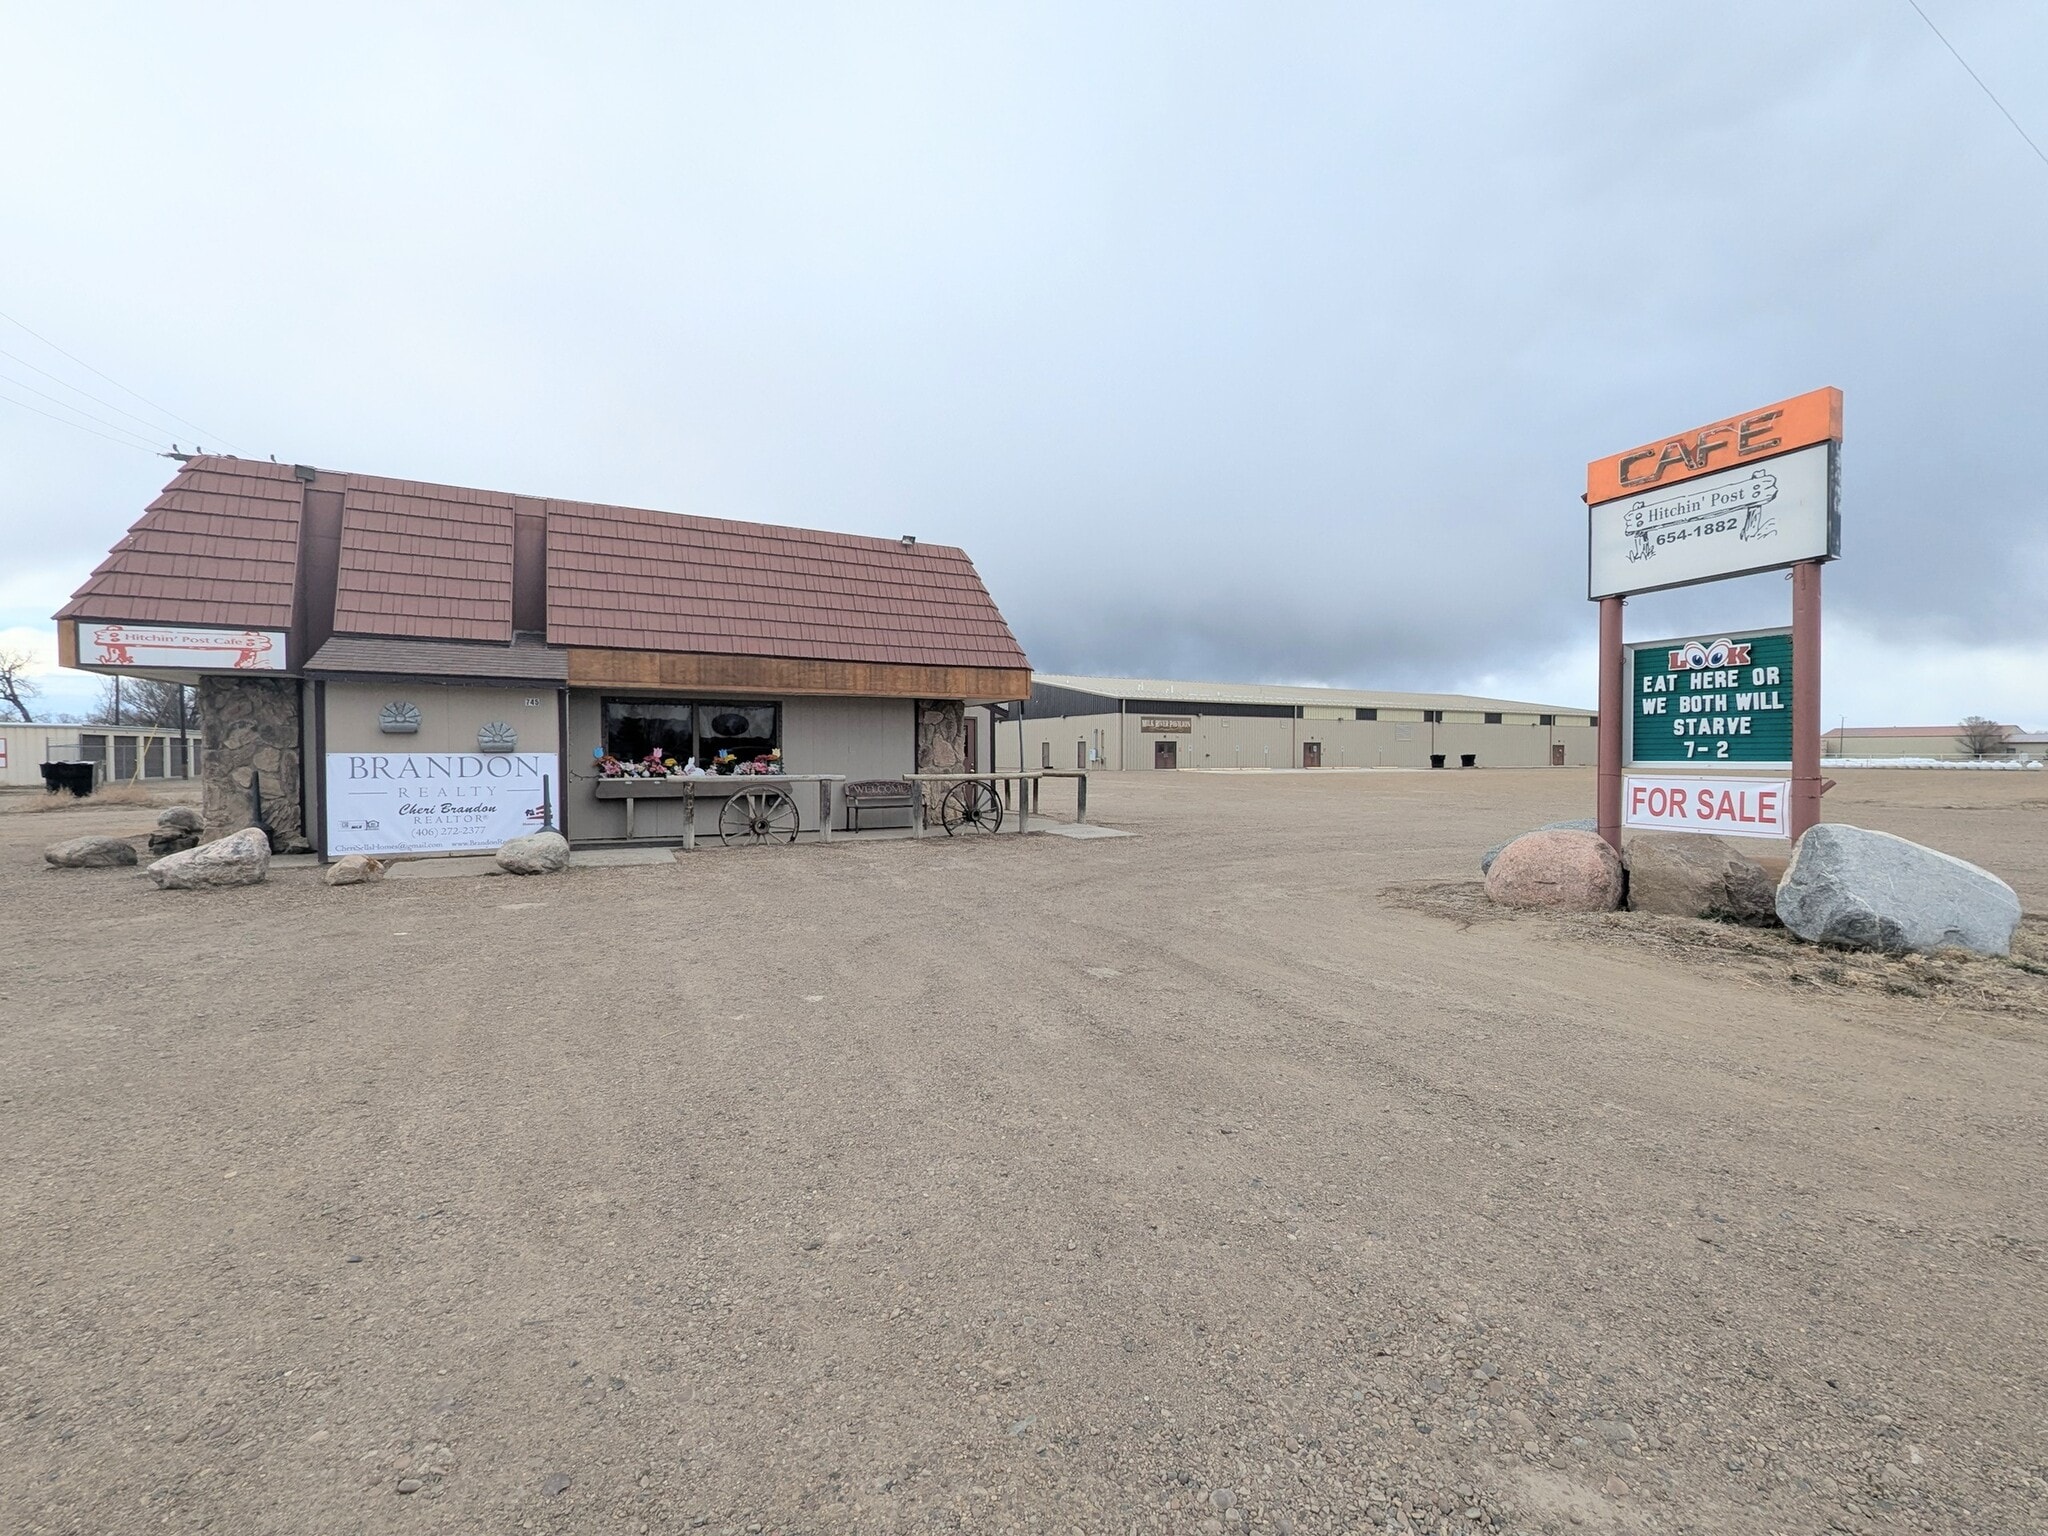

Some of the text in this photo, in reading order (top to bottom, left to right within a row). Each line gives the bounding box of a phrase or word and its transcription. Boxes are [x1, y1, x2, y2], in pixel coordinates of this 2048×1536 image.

[1618, 409, 1784, 487] CAFE
[1648, 488, 1746, 522] Hitchin' Post
[1656, 518, 1738, 545] 654-1882
[125, 633, 243, 645] Hitchin' Post Cafe
[1670, 638, 1751, 670] LOOK
[1643, 666, 1780, 693] EAT HERE OR
[1642, 691, 1784, 715] WE BOTH WILL
[1673, 716, 1752, 736] STARVE
[348, 756, 539, 780] BRANDON
[399, 786, 497, 798] REALTY
[853, 784, 906, 793] WELCOME
[398, 802, 498, 816] Cheri Brandon
[1632, 787, 1777, 823] FOR SALE
[411, 826, 486, 838] (406) 272-2377
